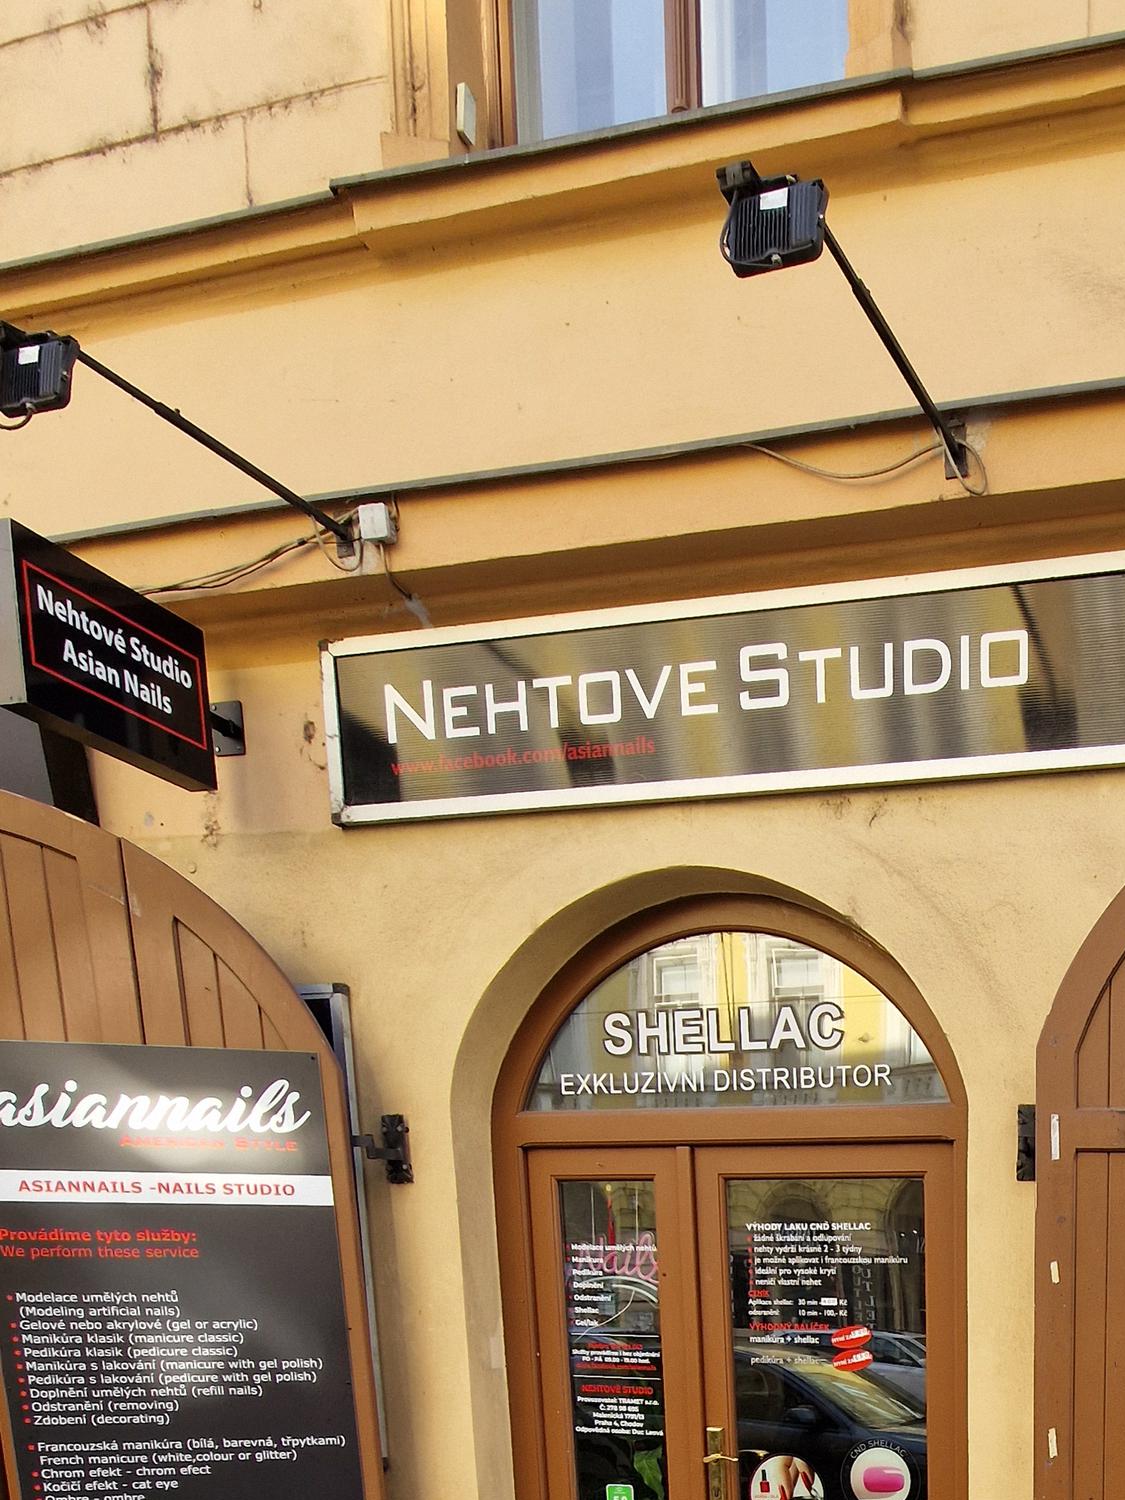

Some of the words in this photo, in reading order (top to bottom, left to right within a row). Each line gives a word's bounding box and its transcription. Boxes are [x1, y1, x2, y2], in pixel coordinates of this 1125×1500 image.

[36, 583, 126, 654] Nehtové
[130, 637, 193, 689] Studio
[63, 639, 120, 688] Asian
[124, 669, 172, 714] Nails
[737, 629, 1031, 712] STUDIO
[391, 736, 655, 775] www.facebook.com/asiannails
[603, 1002, 845, 1056] SHELLAC
[714, 1063, 892, 1092] DISTRIBUTOR
[18, 1179, 142, 1193] ASIANNAILS
[222, 1183, 295, 1196] STUDIO
[784, 1222, 808, 1231] LAKU
[832, 1222, 872, 1230] SHELLAC
[96, 1229, 131, 1243] tyto
[136, 1230, 197, 1243] služby:
[0, 1246, 24, 1258] We
[31, 1245, 92, 1261] perform
[97, 1246, 140, 1258] these
[146, 1246, 199, 1258] service
[16, 1292, 78, 1303] Modelace
[83, 1291, 137, 1304] umělých
[142, 1290, 178, 1302] nehtů
[19, 1306, 84, 1318] (Modeling
[89, 1306, 141, 1317] artificial
[146, 1306, 180, 1318] nails)
[19, 1320, 66, 1330] Gelové
[70, 1320, 102, 1330] nebo
[106, 1319, 162, 1332] akrylové
[166, 1320, 191, 1331] (gel
[213, 1319, 258, 1331] acrylic)
[22, 1334, 82, 1344] Manikúra
[87, 1333, 124, 1344] klasik
[128, 1333, 194, 1345] (manicure
[198, 1333, 244, 1344] classic)
[23, 1348, 81, 1358] Pedikúra
[86, 1347, 123, 1357] klasik
[127, 1346, 188, 1358] (pedicure
[192, 1346, 238, 1357] classic)
[25, 1360, 86, 1371] Manikúra
[90, 1363, 98, 1371] s
[102, 1360, 156, 1370] lakování
[160, 1360, 224, 1371] (manicure
[228, 1359, 255, 1369] with
[259, 1359, 278, 1370] gel
[282, 1358, 323, 1370] polish)
[28, 1374, 85, 1385] Pedikúra
[100, 1374, 154, 1384] lakování
[158, 1373, 219, 1385] (pedicure
[223, 1372, 249, 1382] with
[253, 1373, 272, 1384] gel
[276, 1371, 317, 1383] polish)
[29, 1388, 88, 1400] Doplnění
[92, 1387, 146, 1400] umělých
[150, 1384, 187, 1397] nehtů
[192, 1385, 224, 1397] (refill
[228, 1385, 263, 1397] nails)
[31, 1401, 103, 1412] Odstranění
[108, 1400, 179, 1412] (removing)
[33, 1415, 86, 1426] Zdobení
[91, 1414, 170, 1425] (decorating)
[37, 1441, 118, 1452] Francouzská
[123, 1439, 183, 1449] manikúra
[187, 1438, 219, 1450] (bílá,
[223, 1437, 277, 1448] barevná,
[281, 1435, 346, 1448] třpytkami)
[850, 1443, 866, 1459] CND
[868, 1440, 907, 1457] SHELLAC
[40, 1455, 84, 1465] French
[88, 1453, 148, 1464] manicure
[152, 1451, 235, 1464] (white,colour
[238, 1451, 252, 1460] or
[255, 1450, 297, 1462] glitter)
[41, 1468, 85, 1479] Chrom
[89, 1467, 122, 1477] efekt
[136, 1466, 176, 1476] chrom
[180, 1465, 211, 1475] efect
[43, 1480, 81, 1492] Kočičí
[85, 1480, 118, 1491] efekt
[132, 1480, 152, 1489] cat
[155, 1480, 179, 1491] eye
